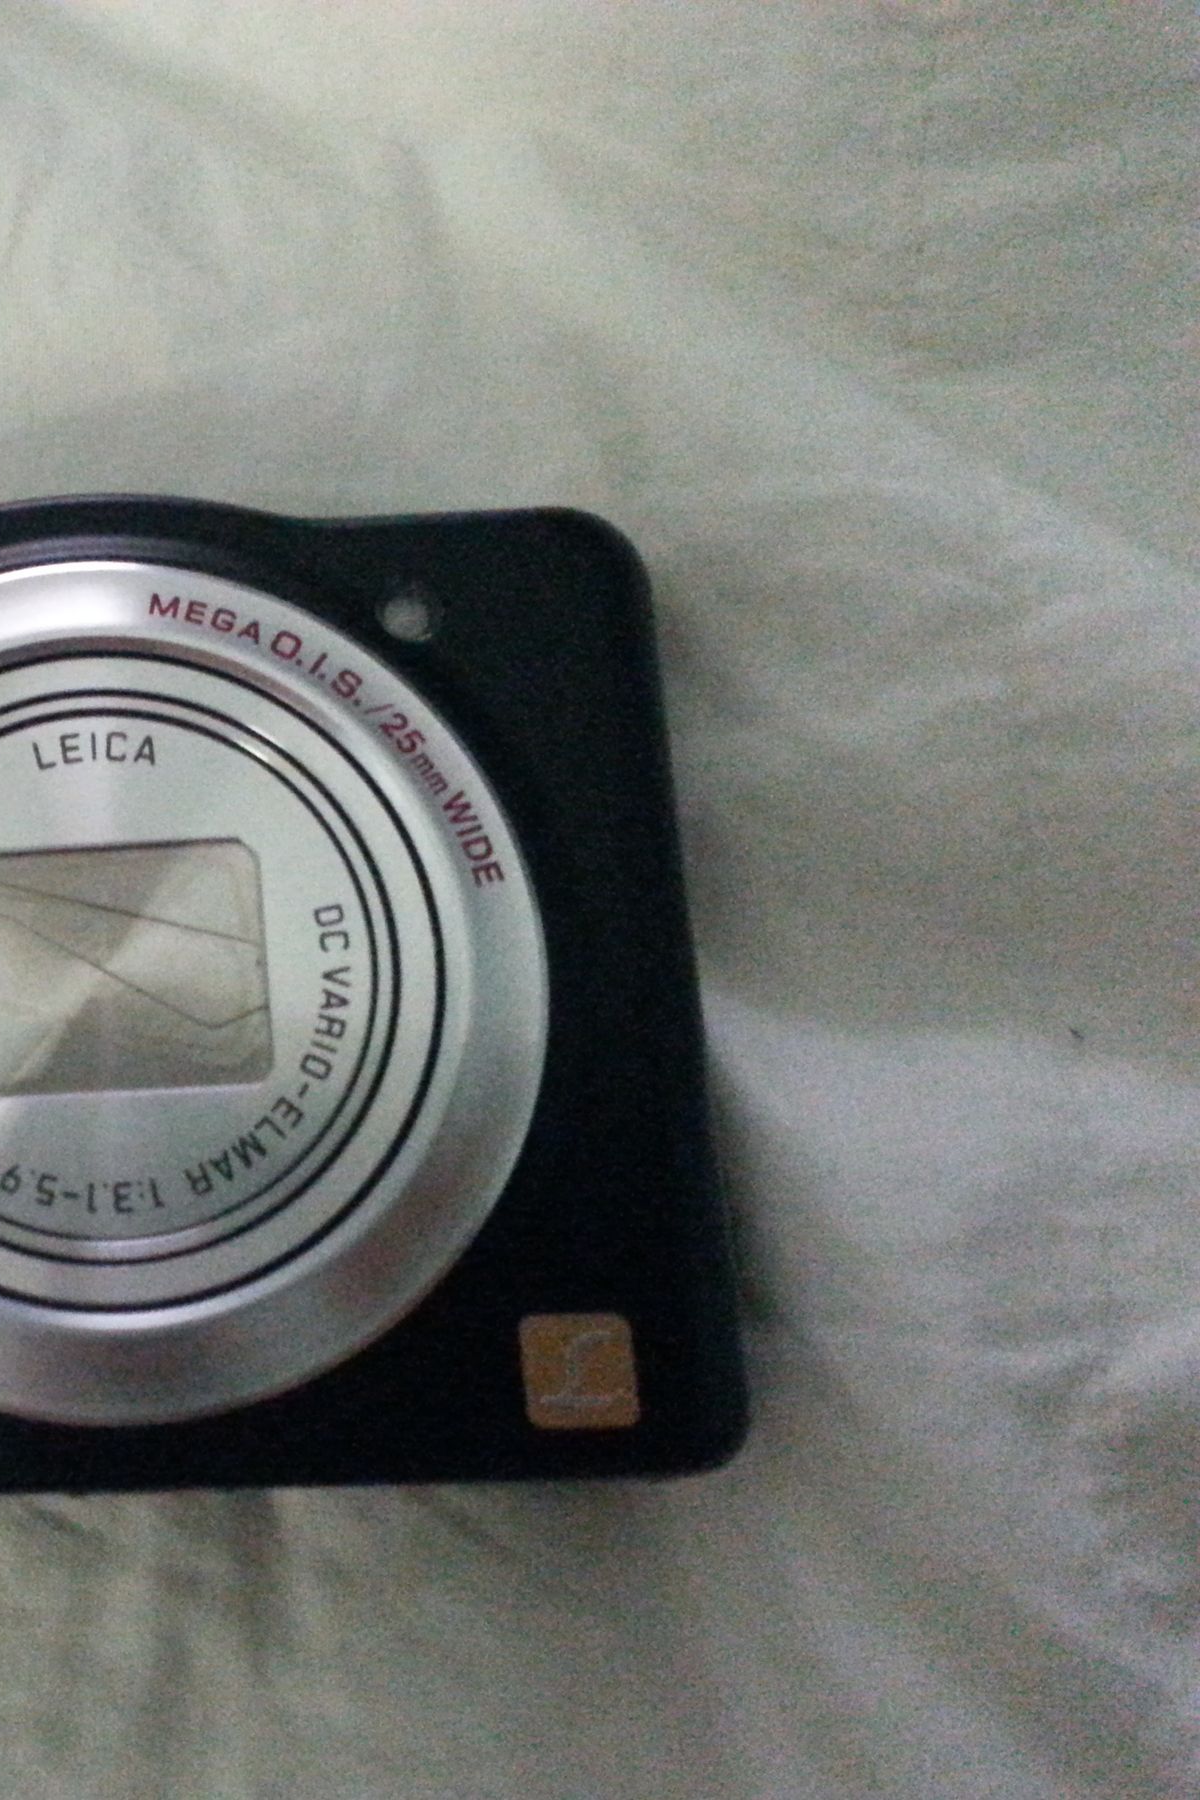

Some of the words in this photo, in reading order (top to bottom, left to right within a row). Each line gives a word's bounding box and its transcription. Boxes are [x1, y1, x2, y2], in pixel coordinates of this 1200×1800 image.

[32, 731, 157, 771] LEICA
[148, 592, 261, 645] MEGA
[442, 790, 505, 888] WIDE
[313, 903, 350, 952] DC
[184, 965, 352, 1197] VARIO-ELMAR
